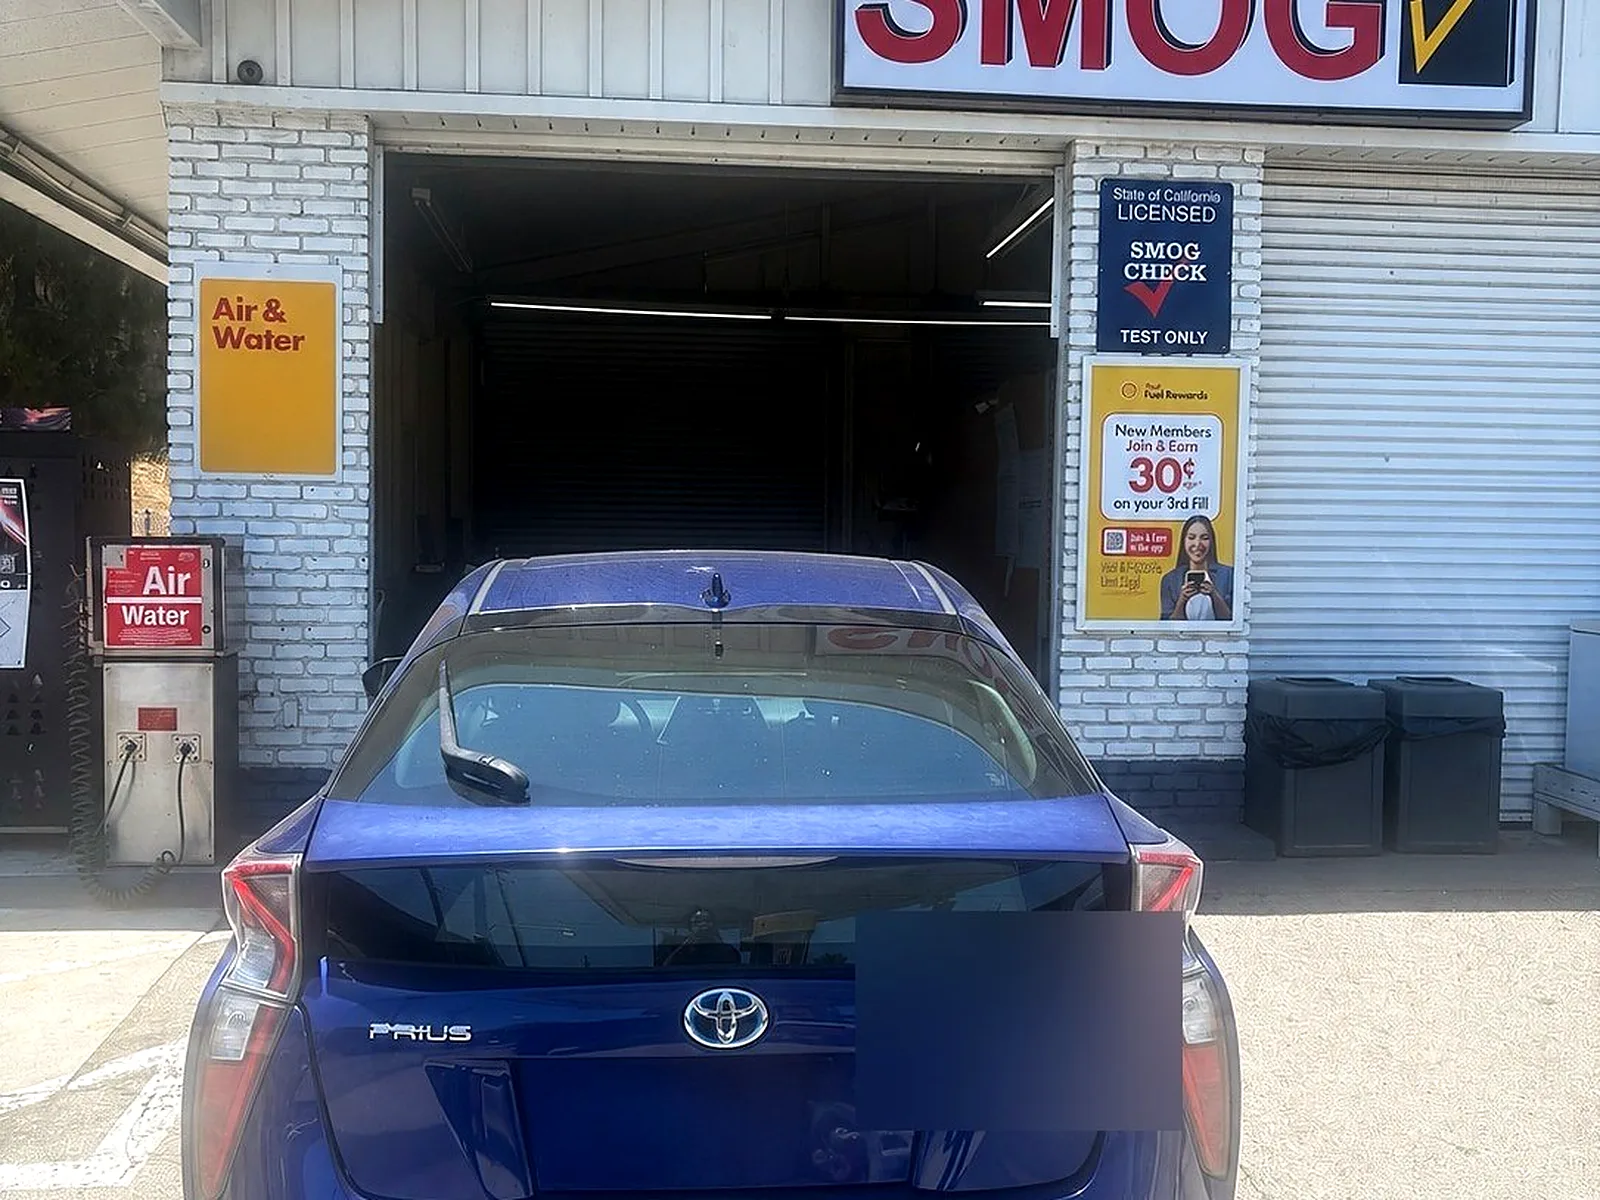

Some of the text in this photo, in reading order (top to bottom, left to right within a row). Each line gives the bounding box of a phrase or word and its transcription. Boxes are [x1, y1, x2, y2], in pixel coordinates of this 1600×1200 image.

[1113, 187, 1145, 200] State
[1148, 188, 1161, 201] of
[1118, 203, 1216, 223] LICENSED
[1130, 241, 1201, 260] SMOG
[1124, 263, 1207, 281] CHECK
[212, 296, 287, 323] Air &
[212, 325, 305, 351] Water
[1120, 329, 1208, 345] TEST ONLY
[1166, 391, 1208, 401] Rewards
[1115, 424, 1212, 438] New Members
[1125, 439, 1153, 452] Join
[1156, 440, 1165, 453] &
[1113, 499, 1131, 510] on
[1132, 500, 1163, 513] your
[1167, 496, 1189, 510] 3rd
[142, 565, 191, 595] Air
[121, 605, 189, 626] Water
[369, 1023, 472, 1041] PRIUS
